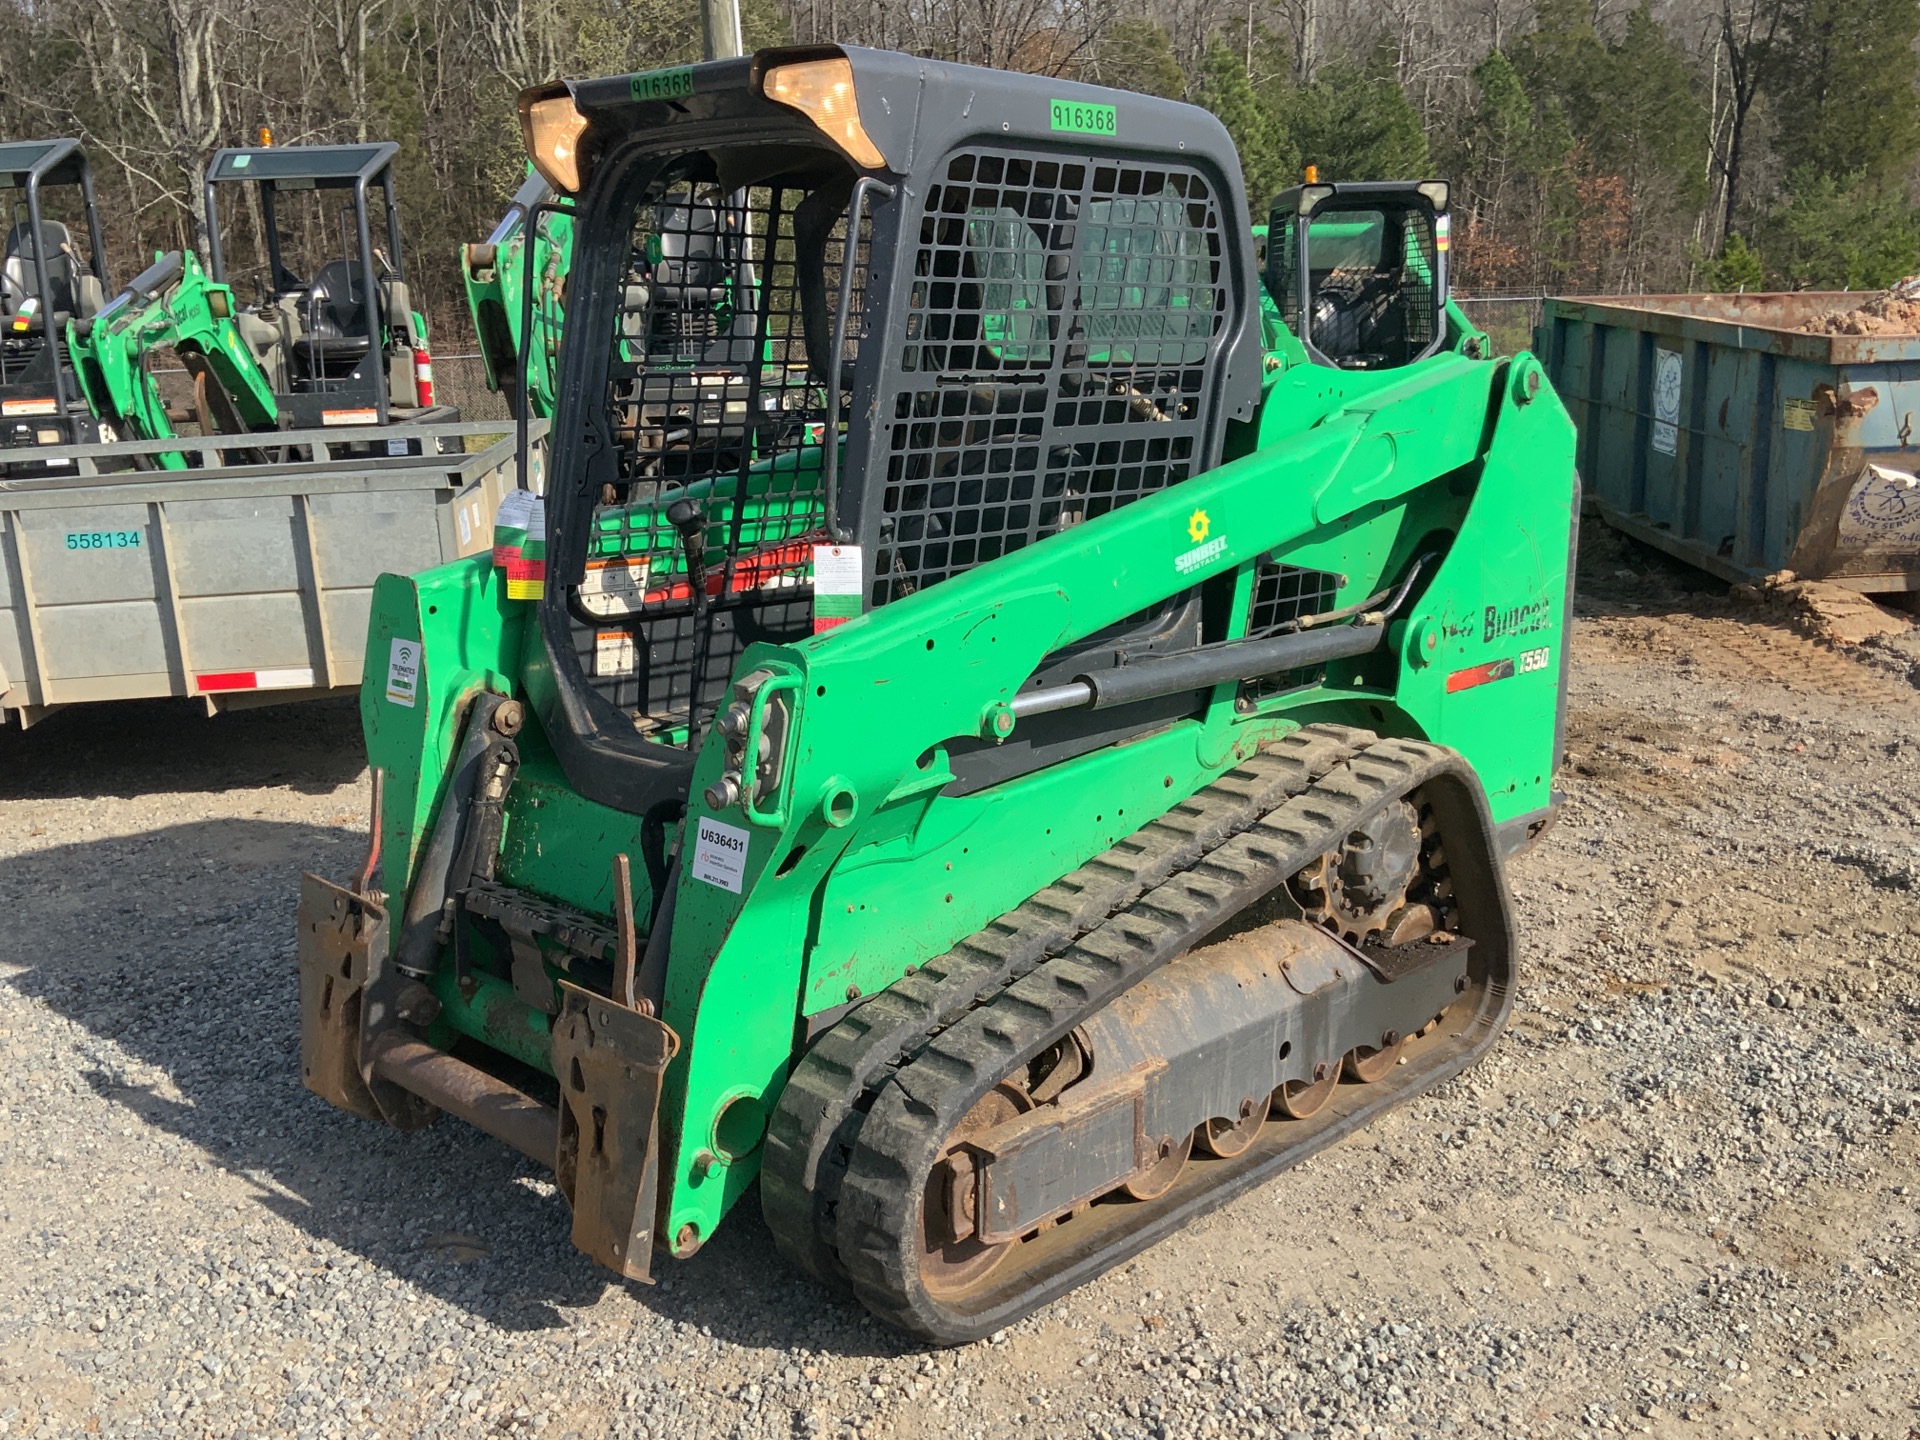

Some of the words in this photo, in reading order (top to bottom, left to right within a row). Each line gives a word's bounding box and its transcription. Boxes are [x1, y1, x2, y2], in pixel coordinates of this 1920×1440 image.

[632, 73, 692, 98] 916368
[1053, 105, 1115, 131] 916368
[67, 531, 141, 550] 558134
[1174, 535, 1229, 572] SUNBELT
[1183, 552, 1221, 576] RENTALS
[1519, 645, 1550, 675] T550
[701, 828, 744, 853] U636431
